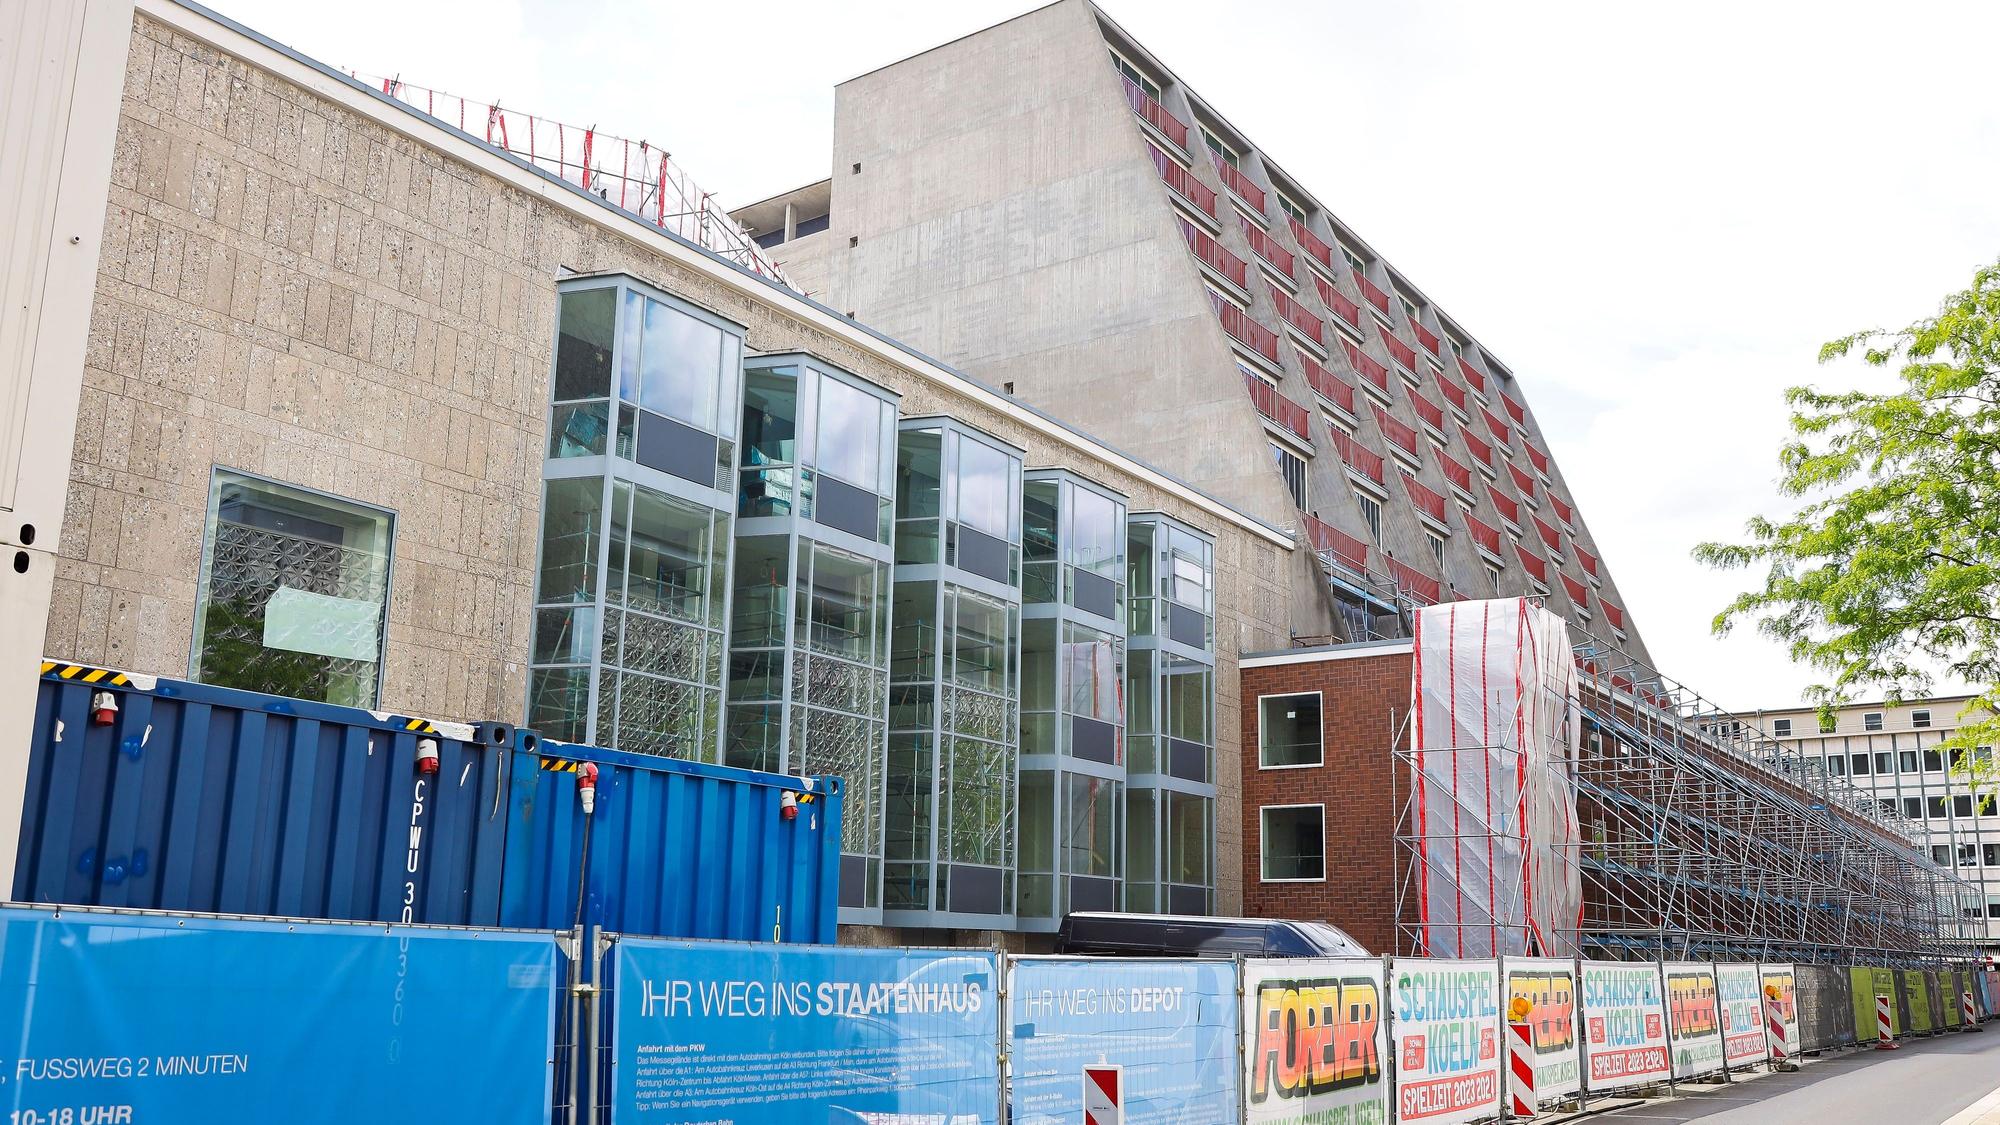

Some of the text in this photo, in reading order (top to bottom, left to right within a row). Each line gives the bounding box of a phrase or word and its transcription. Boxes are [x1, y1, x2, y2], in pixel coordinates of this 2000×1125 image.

[407, 780, 425, 872] CPWU
[641, 980, 981, 1017] IHR WEG INS STAATENHAUS
[1025, 987, 1183, 1017] IHR WEG INS DEPOT
[1399, 971, 1497, 1022] SCHAUSPIEL
[1585, 970, 1660, 1008] SCHAUSPIEL
[1250, 976, 1380, 1104] FOREVER
[1606, 1009, 1645, 1047] KOELN
[16, 1057, 132, 1080] FUSSWEG
[137, 1057, 150, 1077] 2
[155, 1054, 248, 1076] MINUTEN
[637, 1044, 663, 1053] Anfahrt
[664, 1045, 674, 1053] mit
[689, 1043, 706, 1052] PKW
[1428, 1022, 1479, 1074] KOELN
[1594, 1050, 1664, 1077] SPIELZEIT 2023 2024
[1403, 1074, 1495, 1116] SPIELZEIT 2023 2024
[10, 1105, 133, 1125] 10-18 UHR
